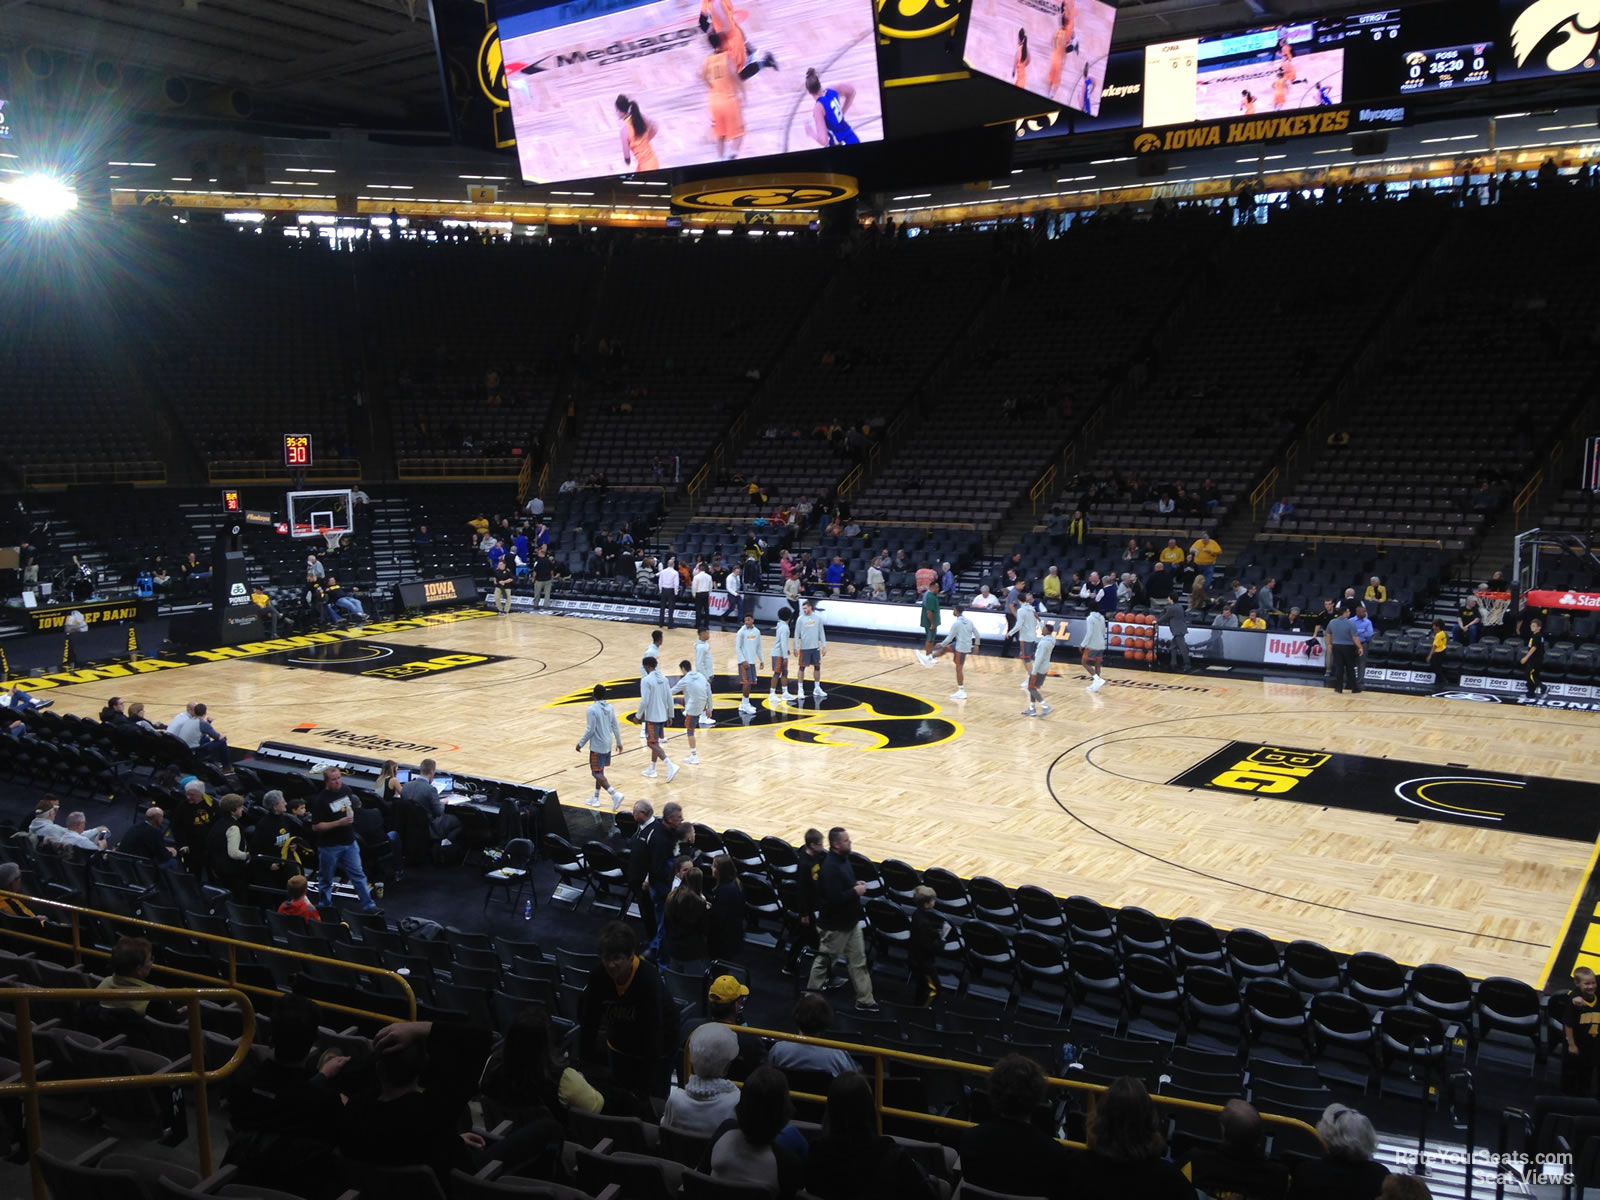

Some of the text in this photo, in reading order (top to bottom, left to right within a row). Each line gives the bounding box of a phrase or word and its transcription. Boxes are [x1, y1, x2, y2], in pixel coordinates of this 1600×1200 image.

[1359, 14, 1387, 23] UTRGV
[1373, 30, 1398, 40] 0 0
[556, 26, 700, 67] Mediaco
[1429, 60, 1464, 74] 35:30
[1474, 57, 1485, 70] 0
[1410, 65, 1421, 78] 0
[1360, 108, 1405, 122] Mycogen
[1163, 110, 1350, 150] IOWA HAWKEYES
[287, 438, 307, 446] 35:29
[289, 447, 306, 462] 30
[424, 581, 455, 596] IOWA
[39, 608, 136, 629] IOW EP BAND
[129, 627, 137, 650] IOWA
[188, 610, 498, 661] HAWKEYES
[0, 659, 187, 695] OWA
[1072, 675, 1209, 692] Mdiacom
[315, 729, 438, 753] Mediacom
